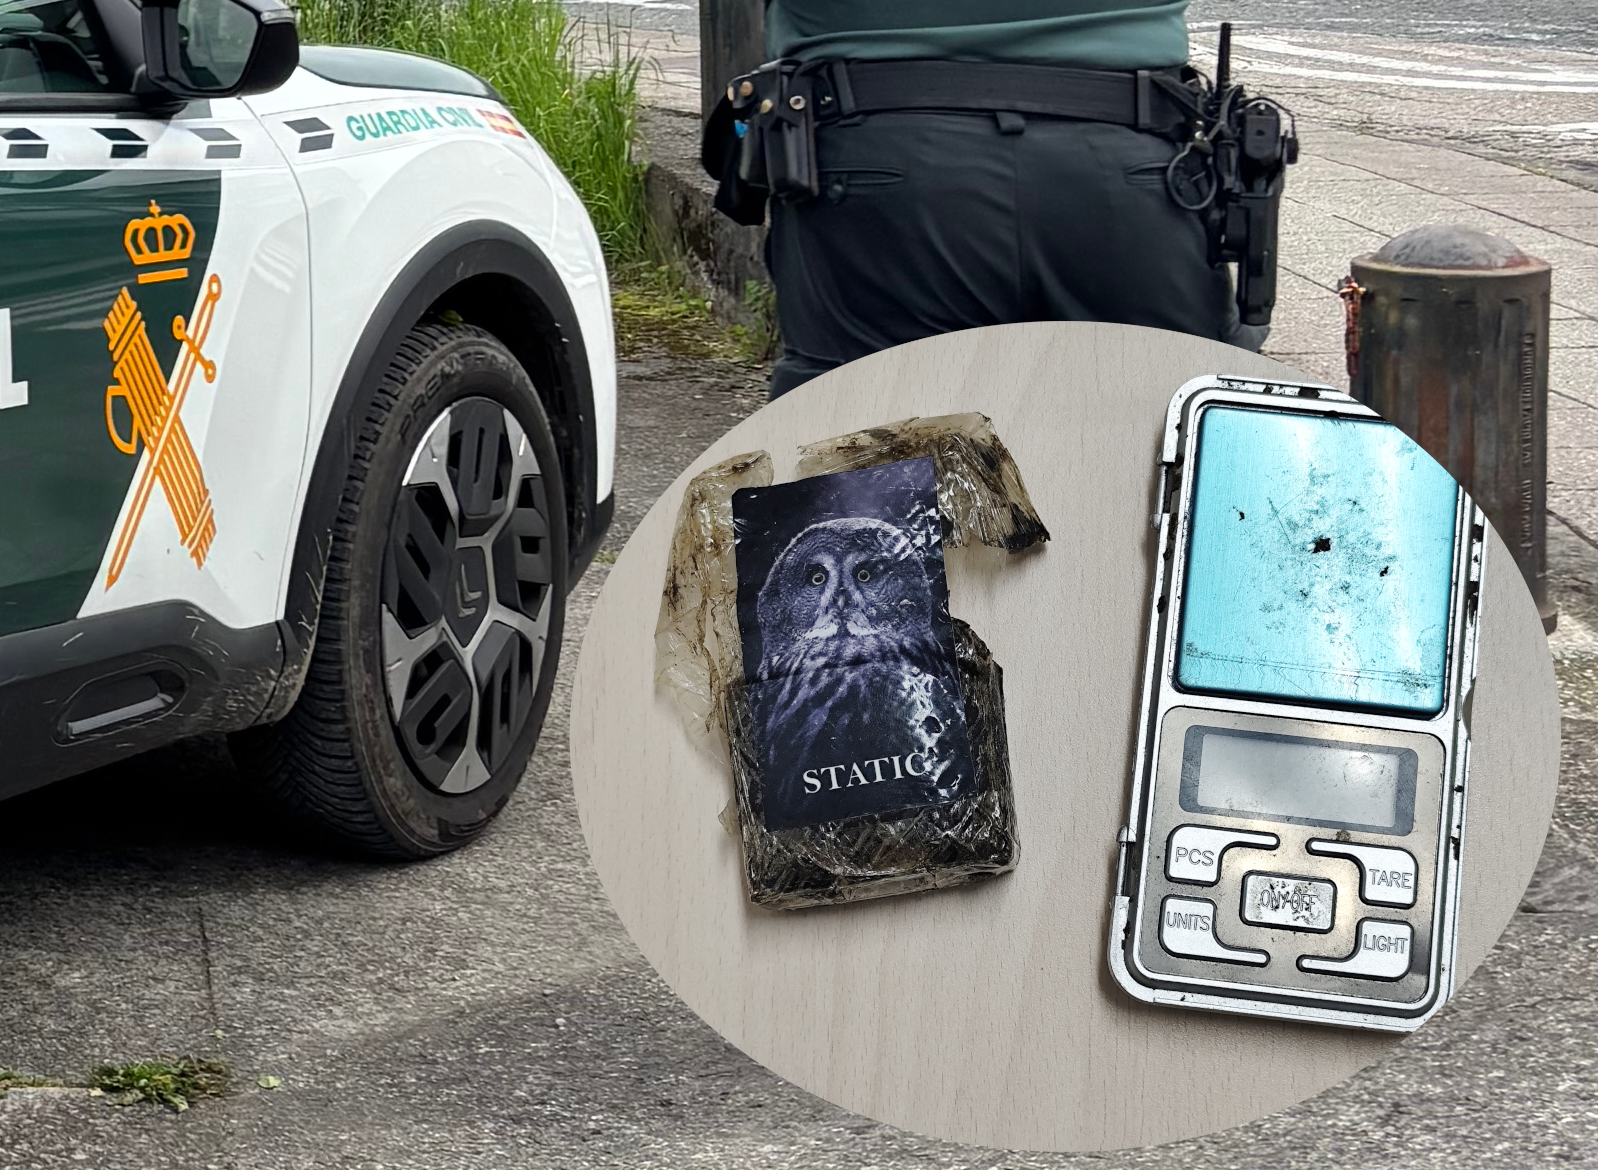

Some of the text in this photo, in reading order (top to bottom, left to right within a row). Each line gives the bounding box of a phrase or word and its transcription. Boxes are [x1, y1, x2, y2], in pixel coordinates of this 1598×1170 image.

[346, 106, 485, 142] GUARDIA CIVIL
[802, 751, 930, 796] STATIC
[1174, 846, 1215, 868] PCS
[1368, 868, 1413, 890] TARE
[1260, 889, 1319, 912] ON/OFF
[1165, 911, 1211, 933] UNITS
[1362, 933, 1409, 955] LIGHT
